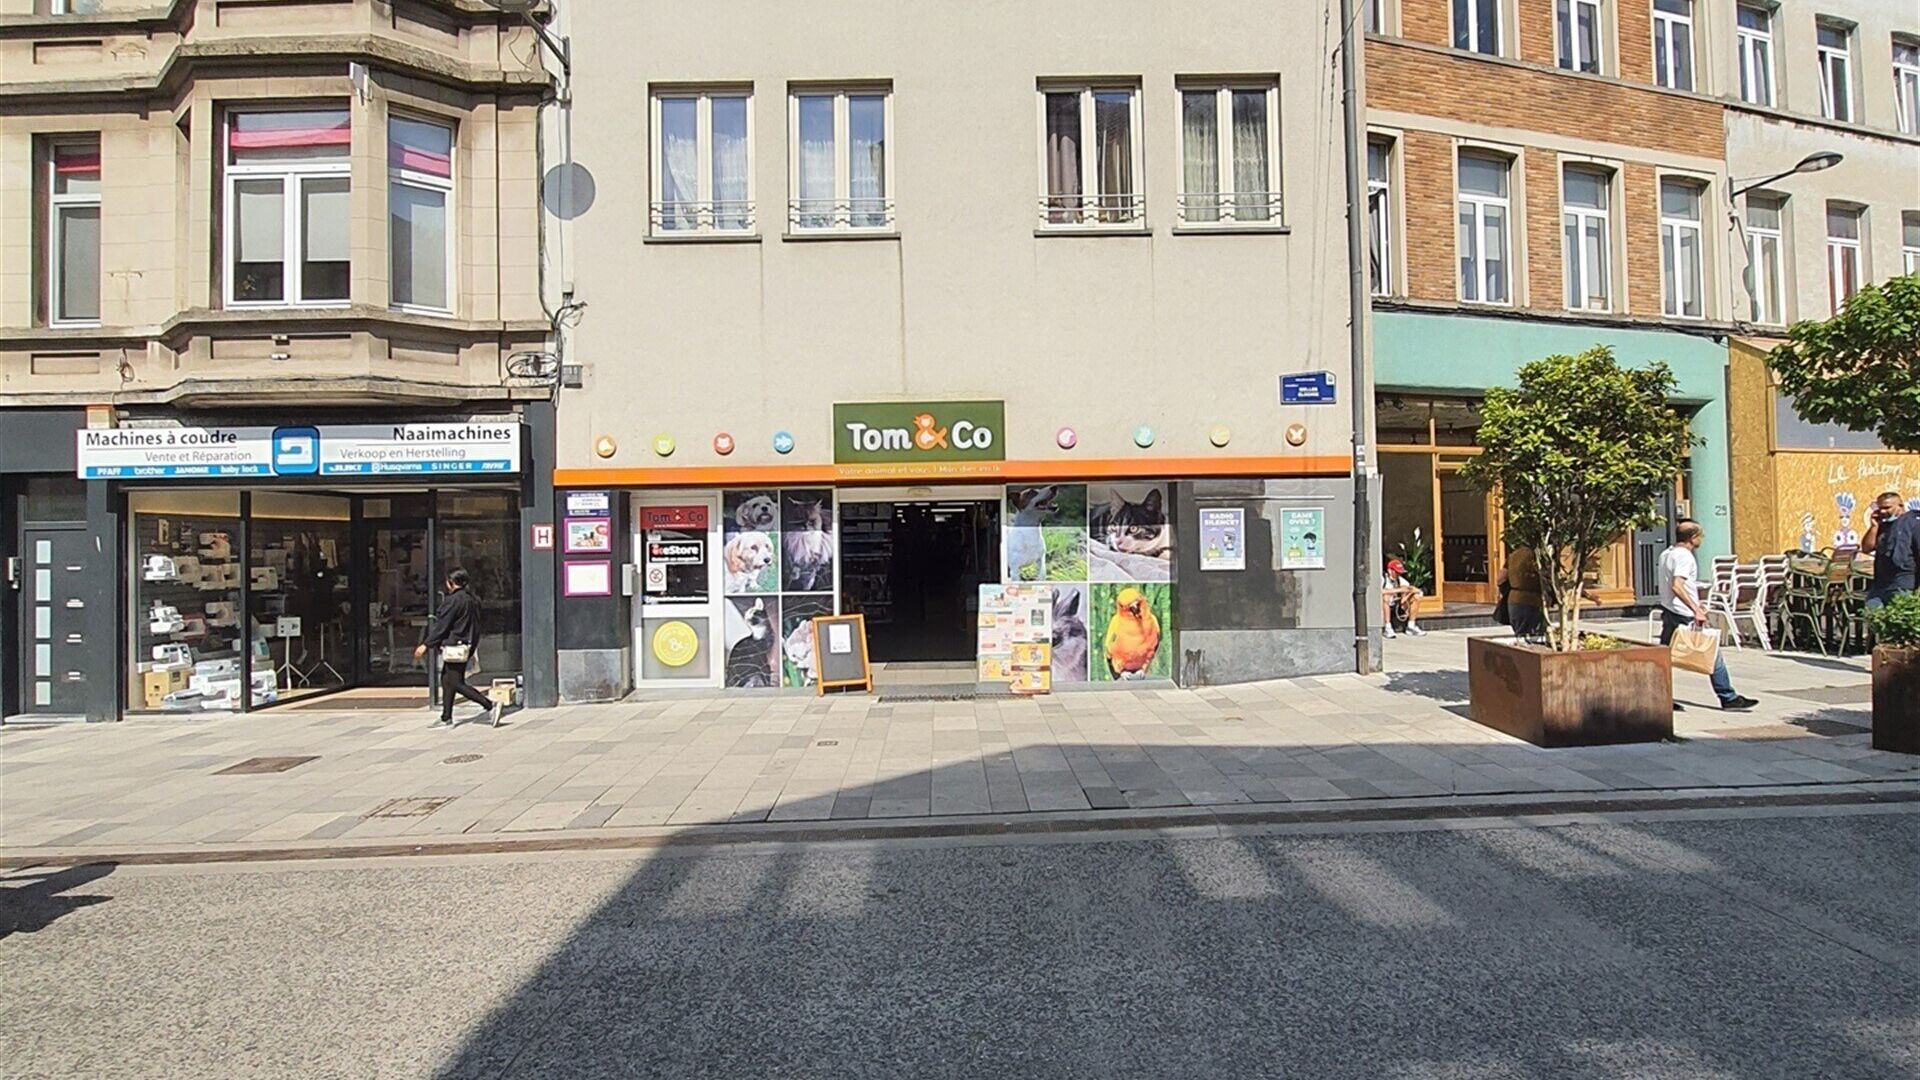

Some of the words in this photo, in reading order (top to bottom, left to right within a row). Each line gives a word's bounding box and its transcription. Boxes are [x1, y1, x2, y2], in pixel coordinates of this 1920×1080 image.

[86, 431, 162, 446] Machines
[167, 431, 176, 444] à
[180, 429, 238, 444] coudre
[393, 425, 511, 441] Naaimachines
[845, 422, 913, 450] Tom
[913, 413, 948, 450] &
[951, 420, 993, 449] Co
[145, 451, 178, 462] Vente
[179, 452, 191, 462] et
[192, 450, 252, 463] Réparation
[340, 448, 387, 461] Verkoop
[388, 450, 403, 458] en
[405, 446, 466, 459] Herstelling
[97, 467, 121, 476] PFAFF
[133, 466, 165, 475] brother
[220, 465, 240, 475] baby
[380, 463, 423, 473] Husqvarna
[431, 462, 472, 471] SINGER
[865, 466, 896, 474] animal
[898, 466, 907, 474] et
[1828, 462, 1849, 484] Le
[647, 511, 670, 522] Tom
[688, 511, 704, 522] Co
[538, 529, 549, 544] H
